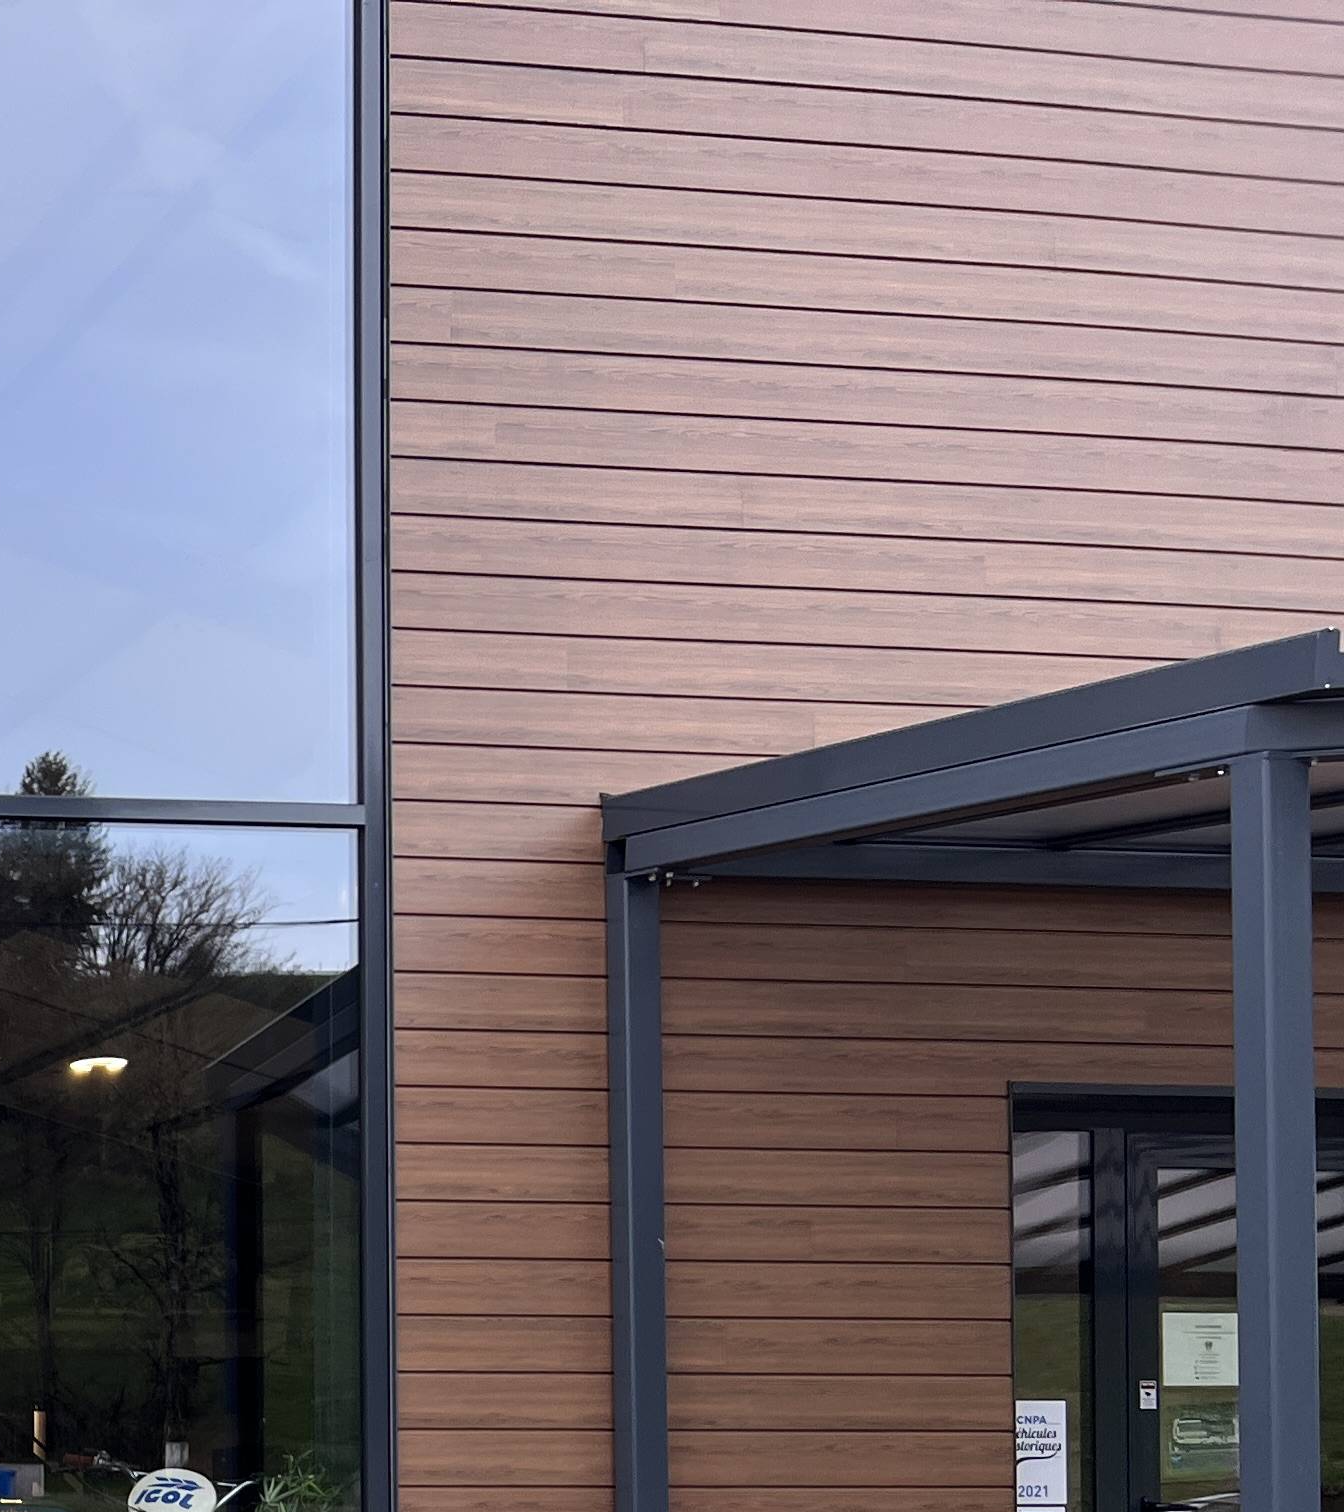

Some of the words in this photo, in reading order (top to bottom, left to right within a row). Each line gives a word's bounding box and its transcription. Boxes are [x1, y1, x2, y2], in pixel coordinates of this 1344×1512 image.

[1016, 1415, 1047, 1425] CNPA
[1015, 1427, 1057, 1439] éhicules
[1016, 1441, 1062, 1454] storiques
[1018, 1485, 1048, 1498] 2021
[134, 1489, 195, 1510] IGOL
